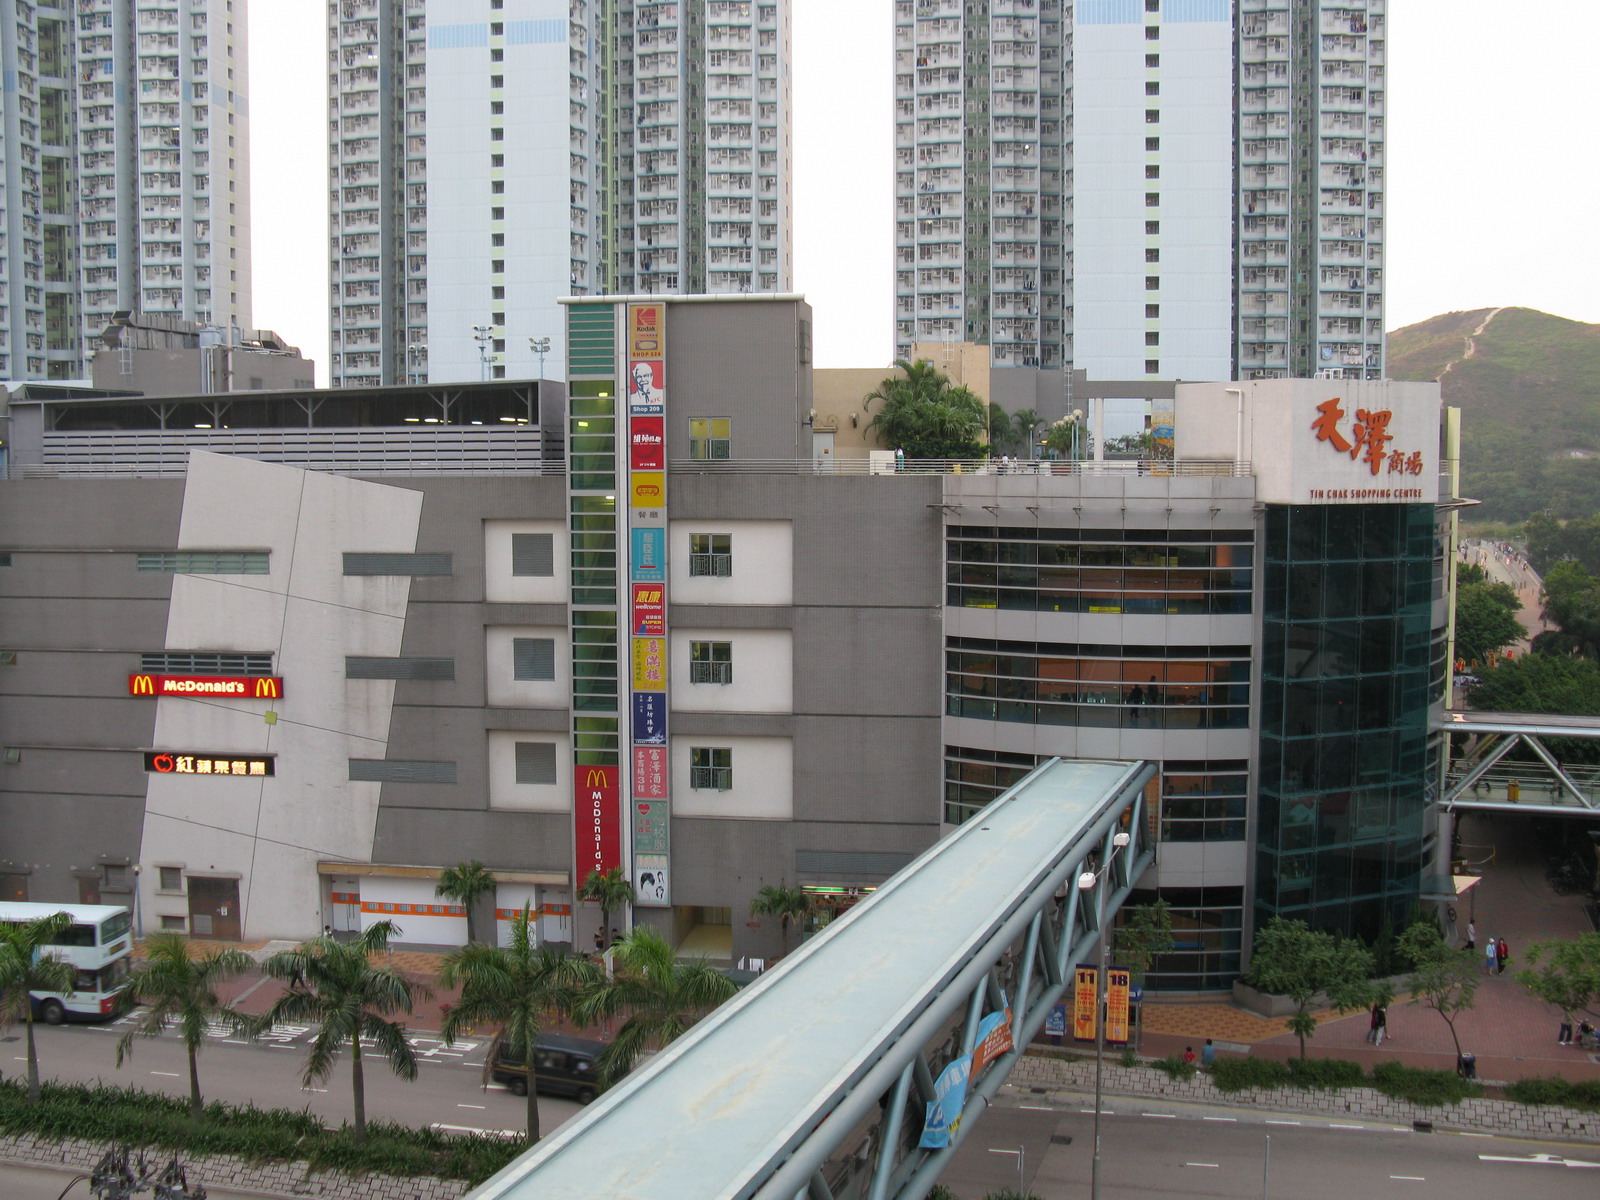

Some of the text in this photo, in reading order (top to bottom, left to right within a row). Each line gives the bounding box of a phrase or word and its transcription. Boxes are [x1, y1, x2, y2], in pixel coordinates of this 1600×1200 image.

[1310, 397, 1423, 476] 天澤商場
[1310, 488, 1422, 499] TIN CHAK SHOPPING CENTRE
[636, 591, 661, 603] 惠康
[163, 680, 245, 693] McDonald's
[176, 756, 265, 775] 紅蘋果餐廳
[592, 791, 603, 871] McDonald's
[1078, 972, 1095, 984] 11
[1109, 974, 1128, 986] 18
